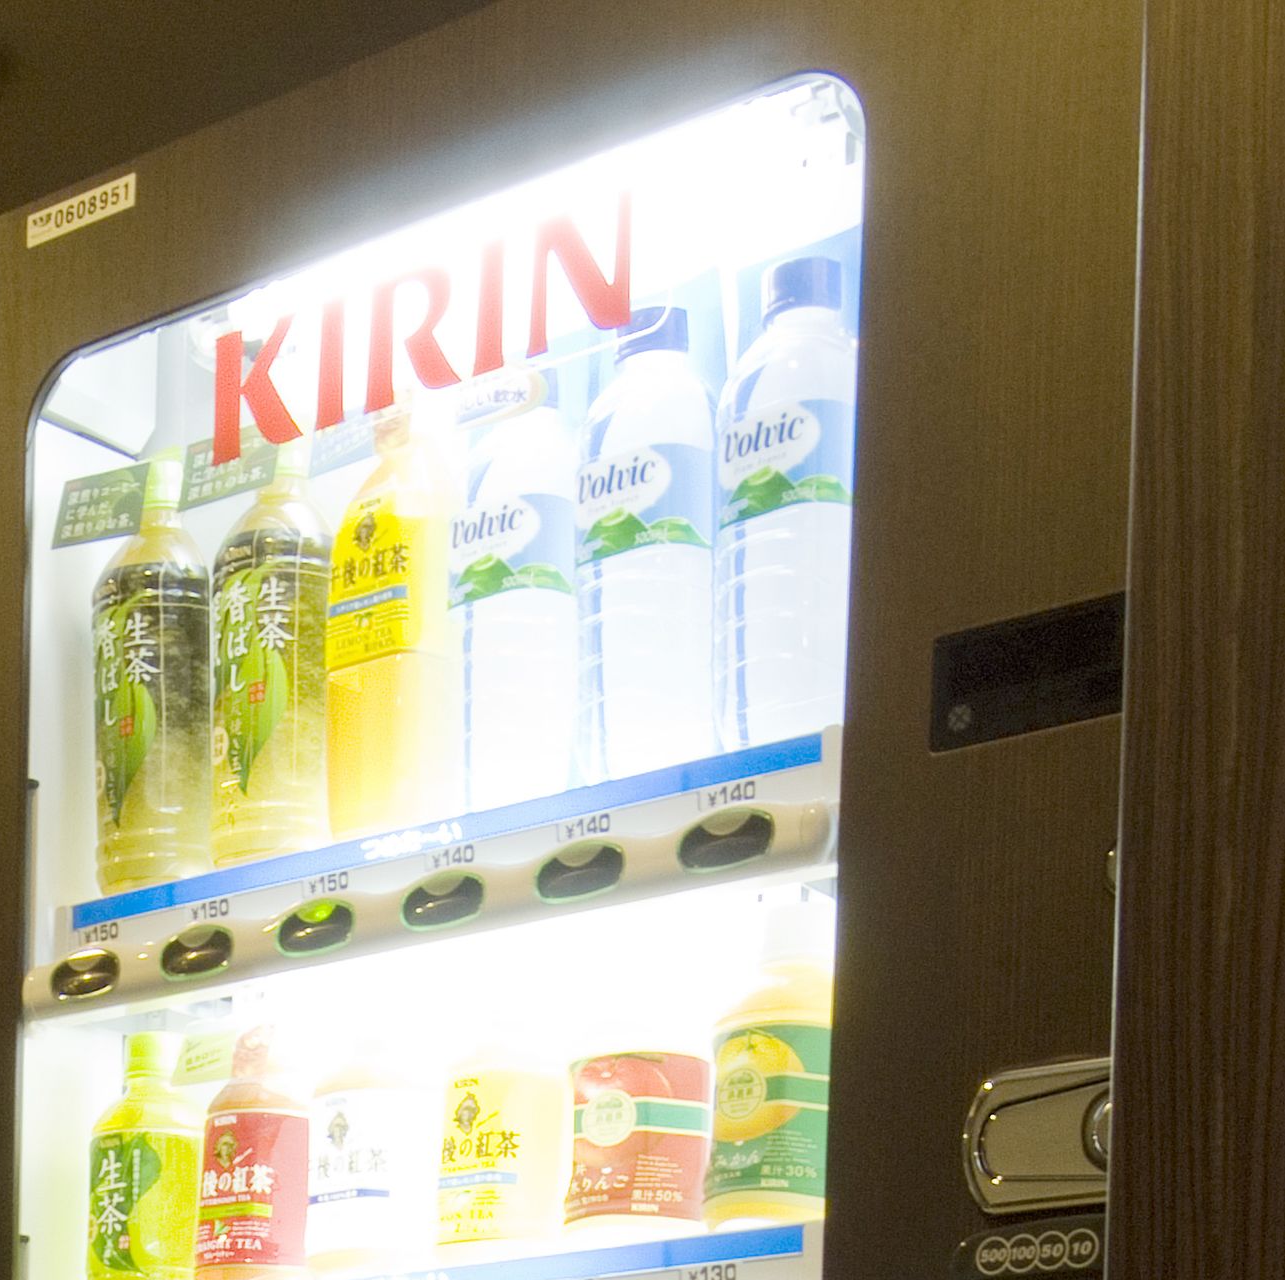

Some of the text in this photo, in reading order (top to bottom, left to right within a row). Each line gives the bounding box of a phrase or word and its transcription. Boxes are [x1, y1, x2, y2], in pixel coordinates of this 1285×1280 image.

[54, 182, 129, 228] 0608951
[212, 188, 632, 467] KIRIN
[724, 412, 804, 463] Volvic
[579, 455, 656, 504] Volvic
[452, 505, 524, 549] Volvic
[256, 576, 295, 650] 生茶
[123, 612, 161, 683] 生茶
[708, 781, 756, 807] ¥140
[565, 814, 611, 839] ¥140
[432, 845, 475, 868] ¥140
[309, 872, 349, 894] ¥150
[191, 900, 229, 920] ¥150
[84, 922, 118, 943] ¥150
[317, 1147, 388, 1181] 後の紅茶
[442, 1130, 521, 1164] 後の紅茶
[97, 1150, 127, 1234] 生茶
[202, 1165, 274, 1197] 後の紅茶
[236, 1238, 262, 1250] TEA
[980, 1240, 1093, 1264] 500 100 50 10
